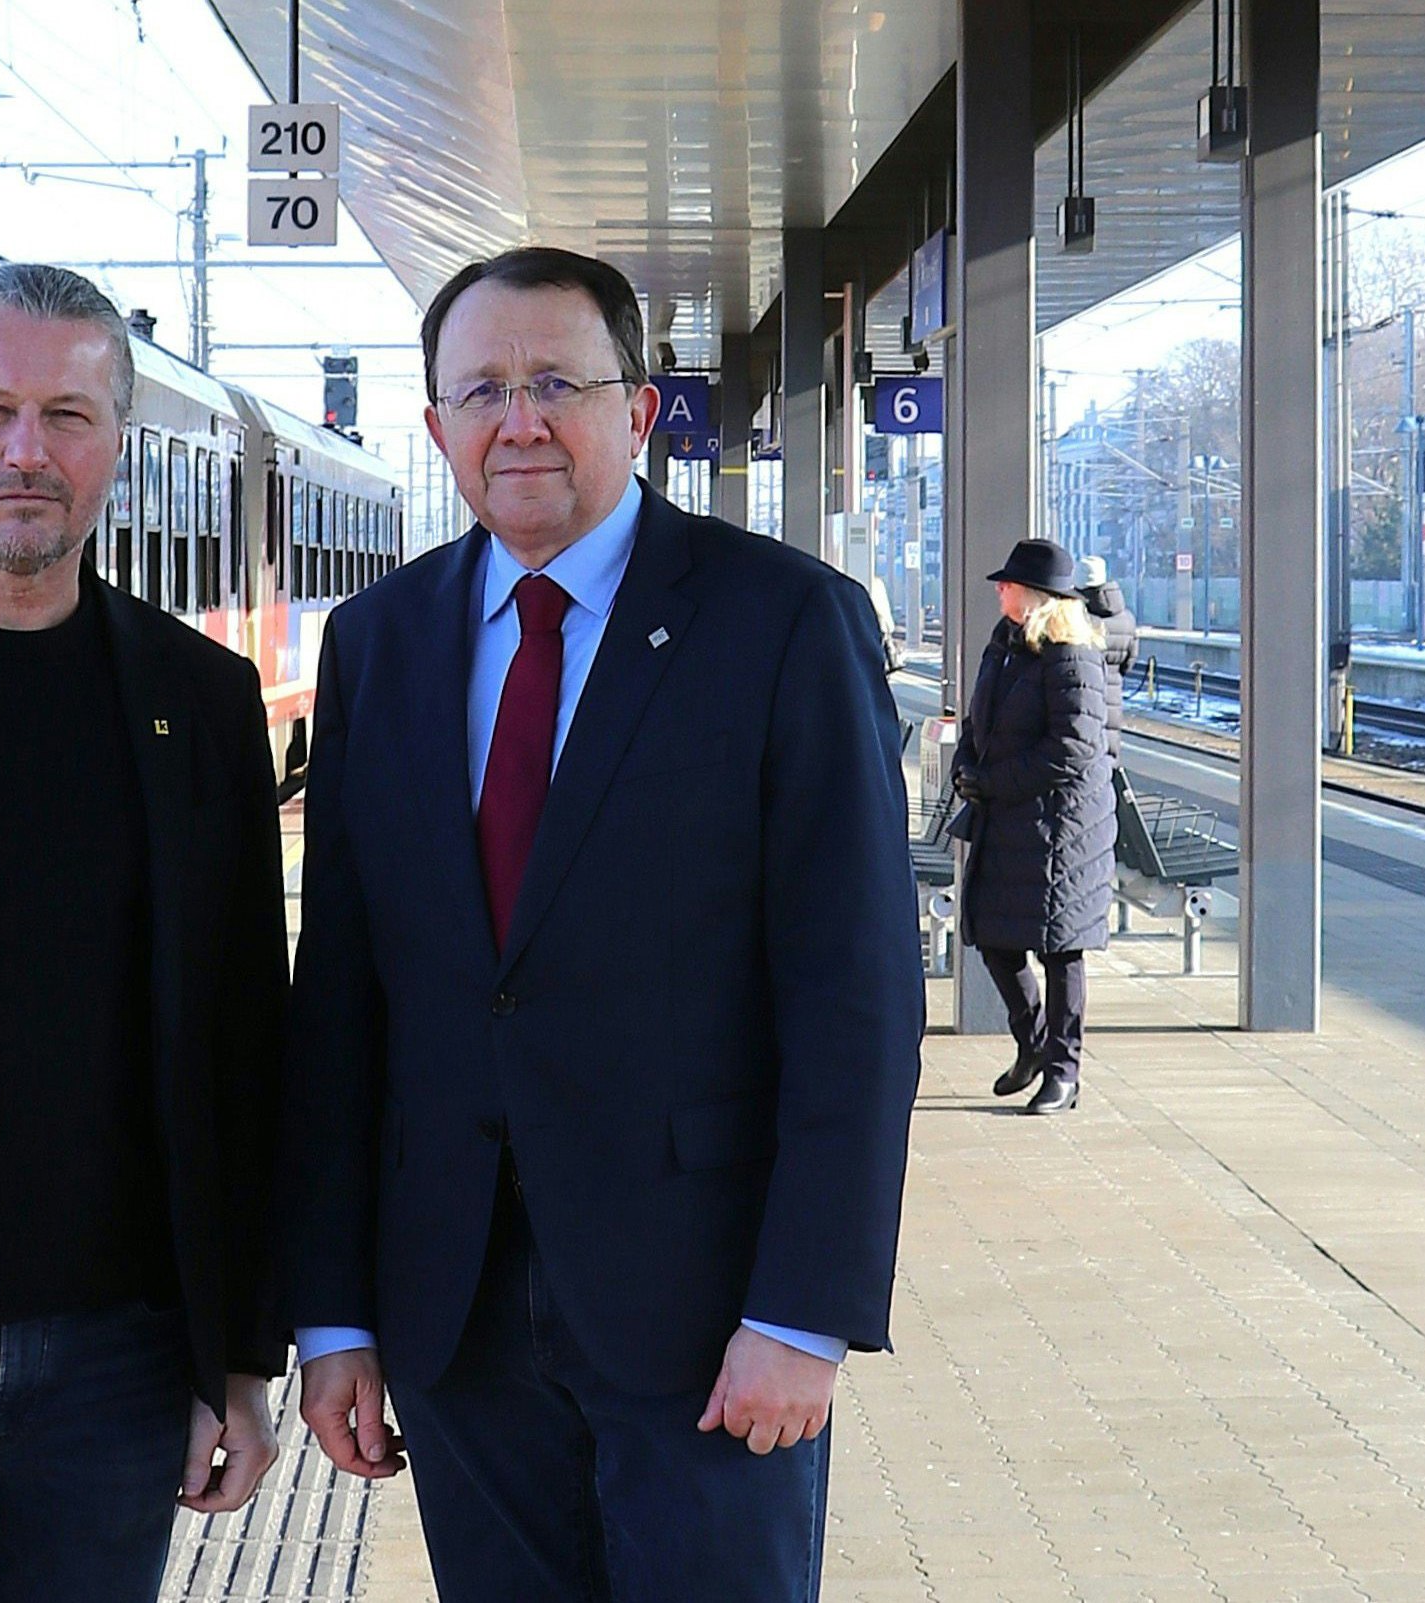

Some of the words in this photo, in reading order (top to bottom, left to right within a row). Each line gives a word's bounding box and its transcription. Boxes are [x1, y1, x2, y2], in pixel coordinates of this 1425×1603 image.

[261, 121, 326, 155] 210
[266, 196, 319, 230] 70
[667, 394, 693, 422] A
[893, 387, 920, 424] 6
